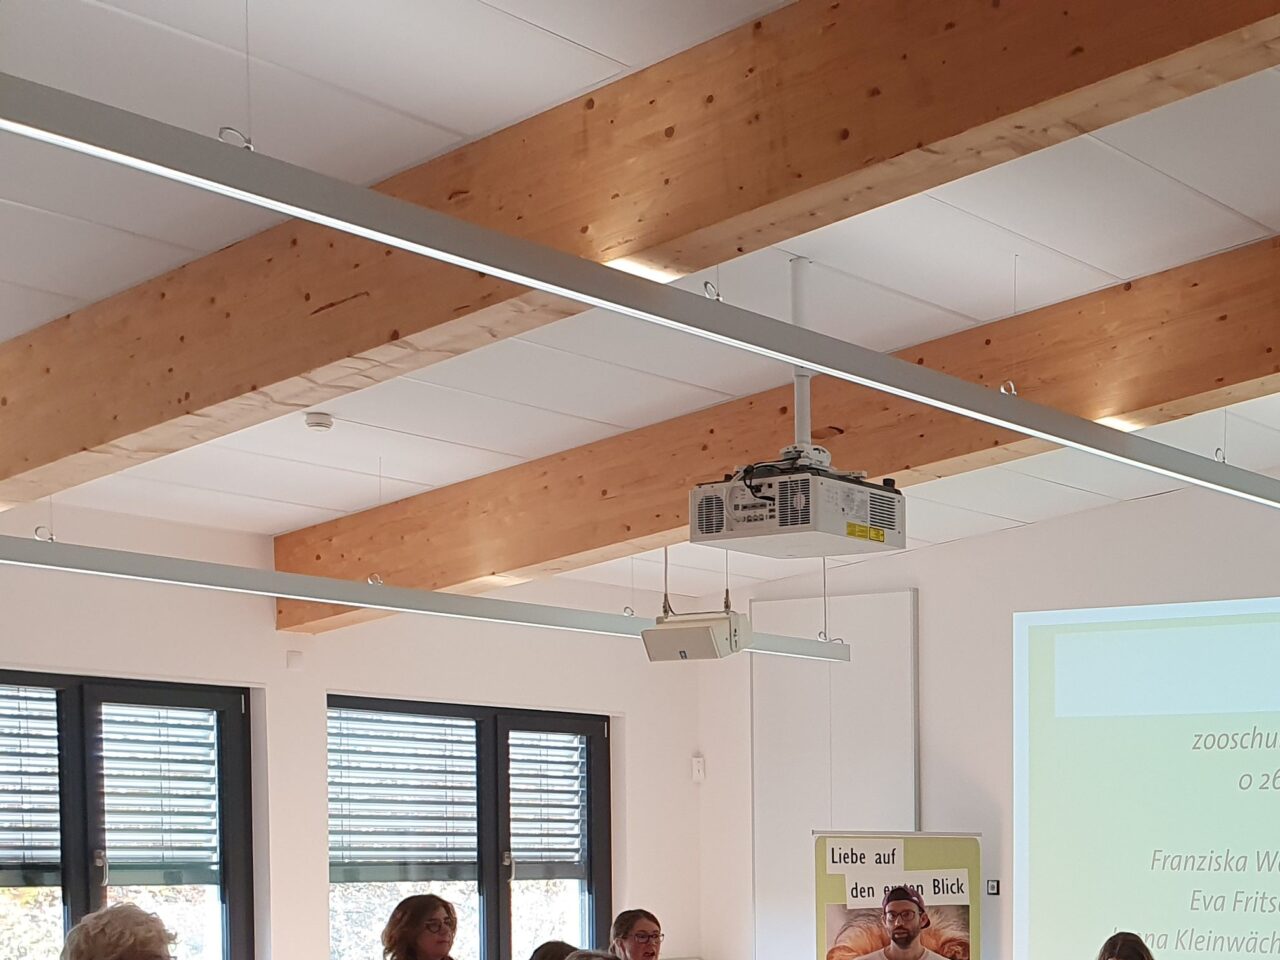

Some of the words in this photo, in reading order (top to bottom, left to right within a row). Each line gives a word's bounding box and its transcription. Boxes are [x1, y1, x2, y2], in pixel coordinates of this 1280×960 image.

[831, 847, 866, 865] Liebe
[874, 847, 897, 865] auf
[1151, 848, 1248, 873] Franziska
[850, 882, 875, 899] den
[932, 877, 965, 896] Blick
[1190, 889, 1226, 912] Eva
